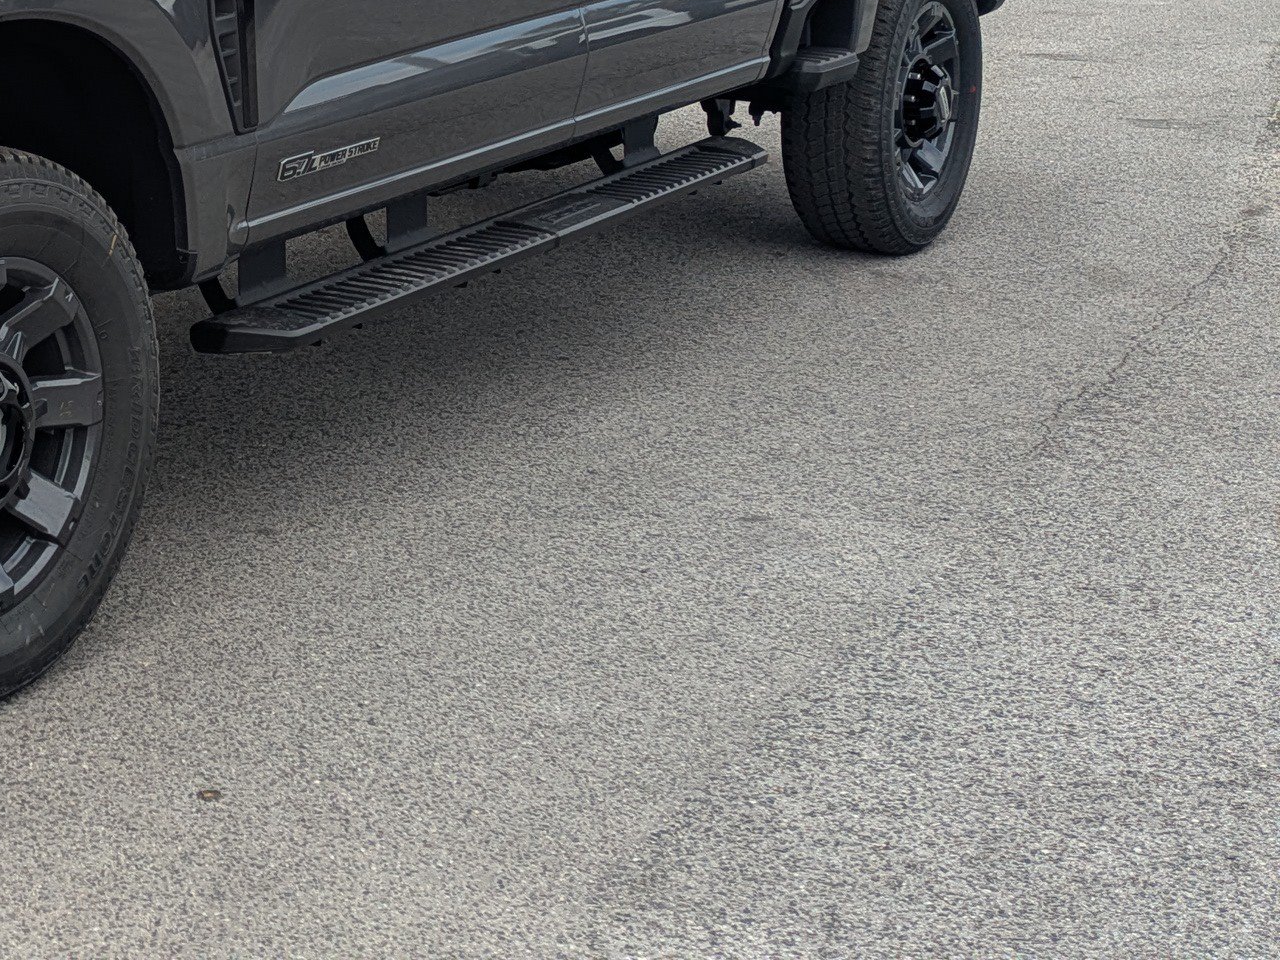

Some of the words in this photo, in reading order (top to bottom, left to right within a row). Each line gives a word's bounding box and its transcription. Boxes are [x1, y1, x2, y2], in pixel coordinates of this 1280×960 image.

[279, 152, 319, 181] 6.7L
[320, 148, 348, 167] POWER
[347, 140, 380, 158] STROKE
